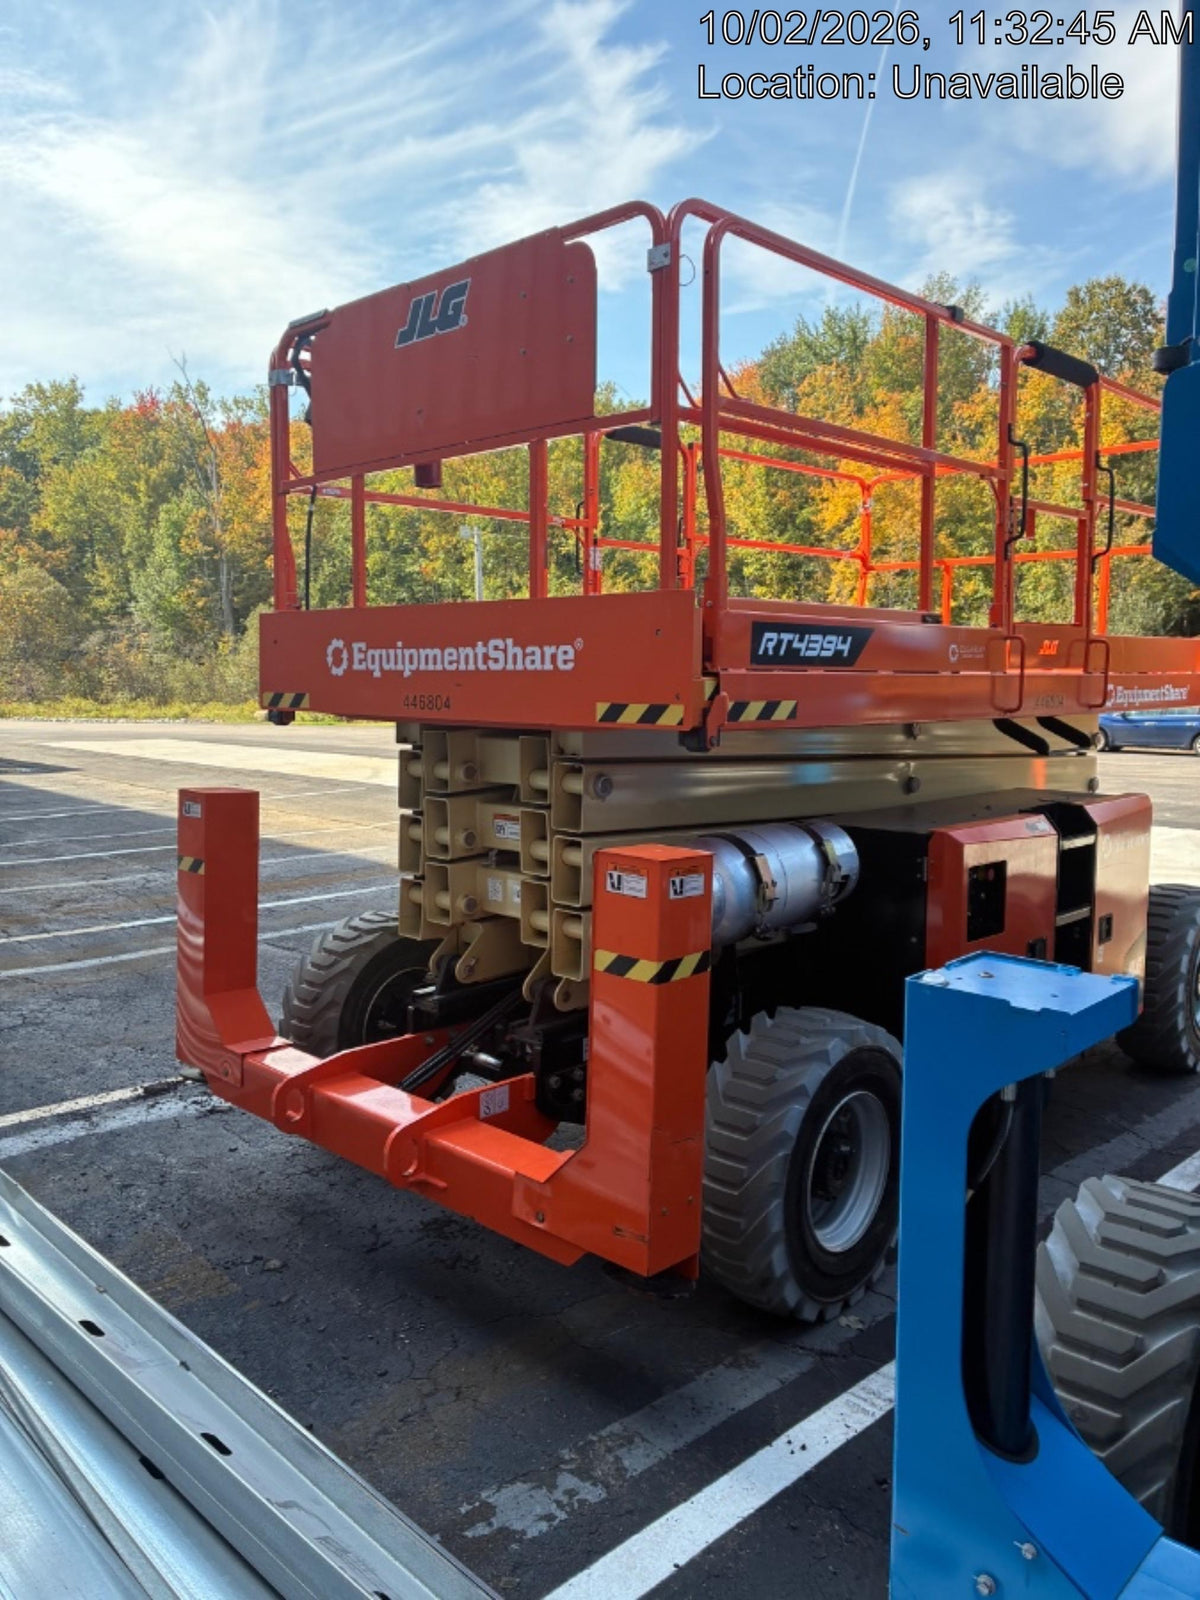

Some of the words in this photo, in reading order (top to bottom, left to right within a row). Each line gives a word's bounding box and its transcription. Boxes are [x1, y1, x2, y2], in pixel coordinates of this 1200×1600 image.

[394, 277, 472, 349] JLG
[758, 632, 852, 657] RT4394
[403, 694, 451, 711] 446804
